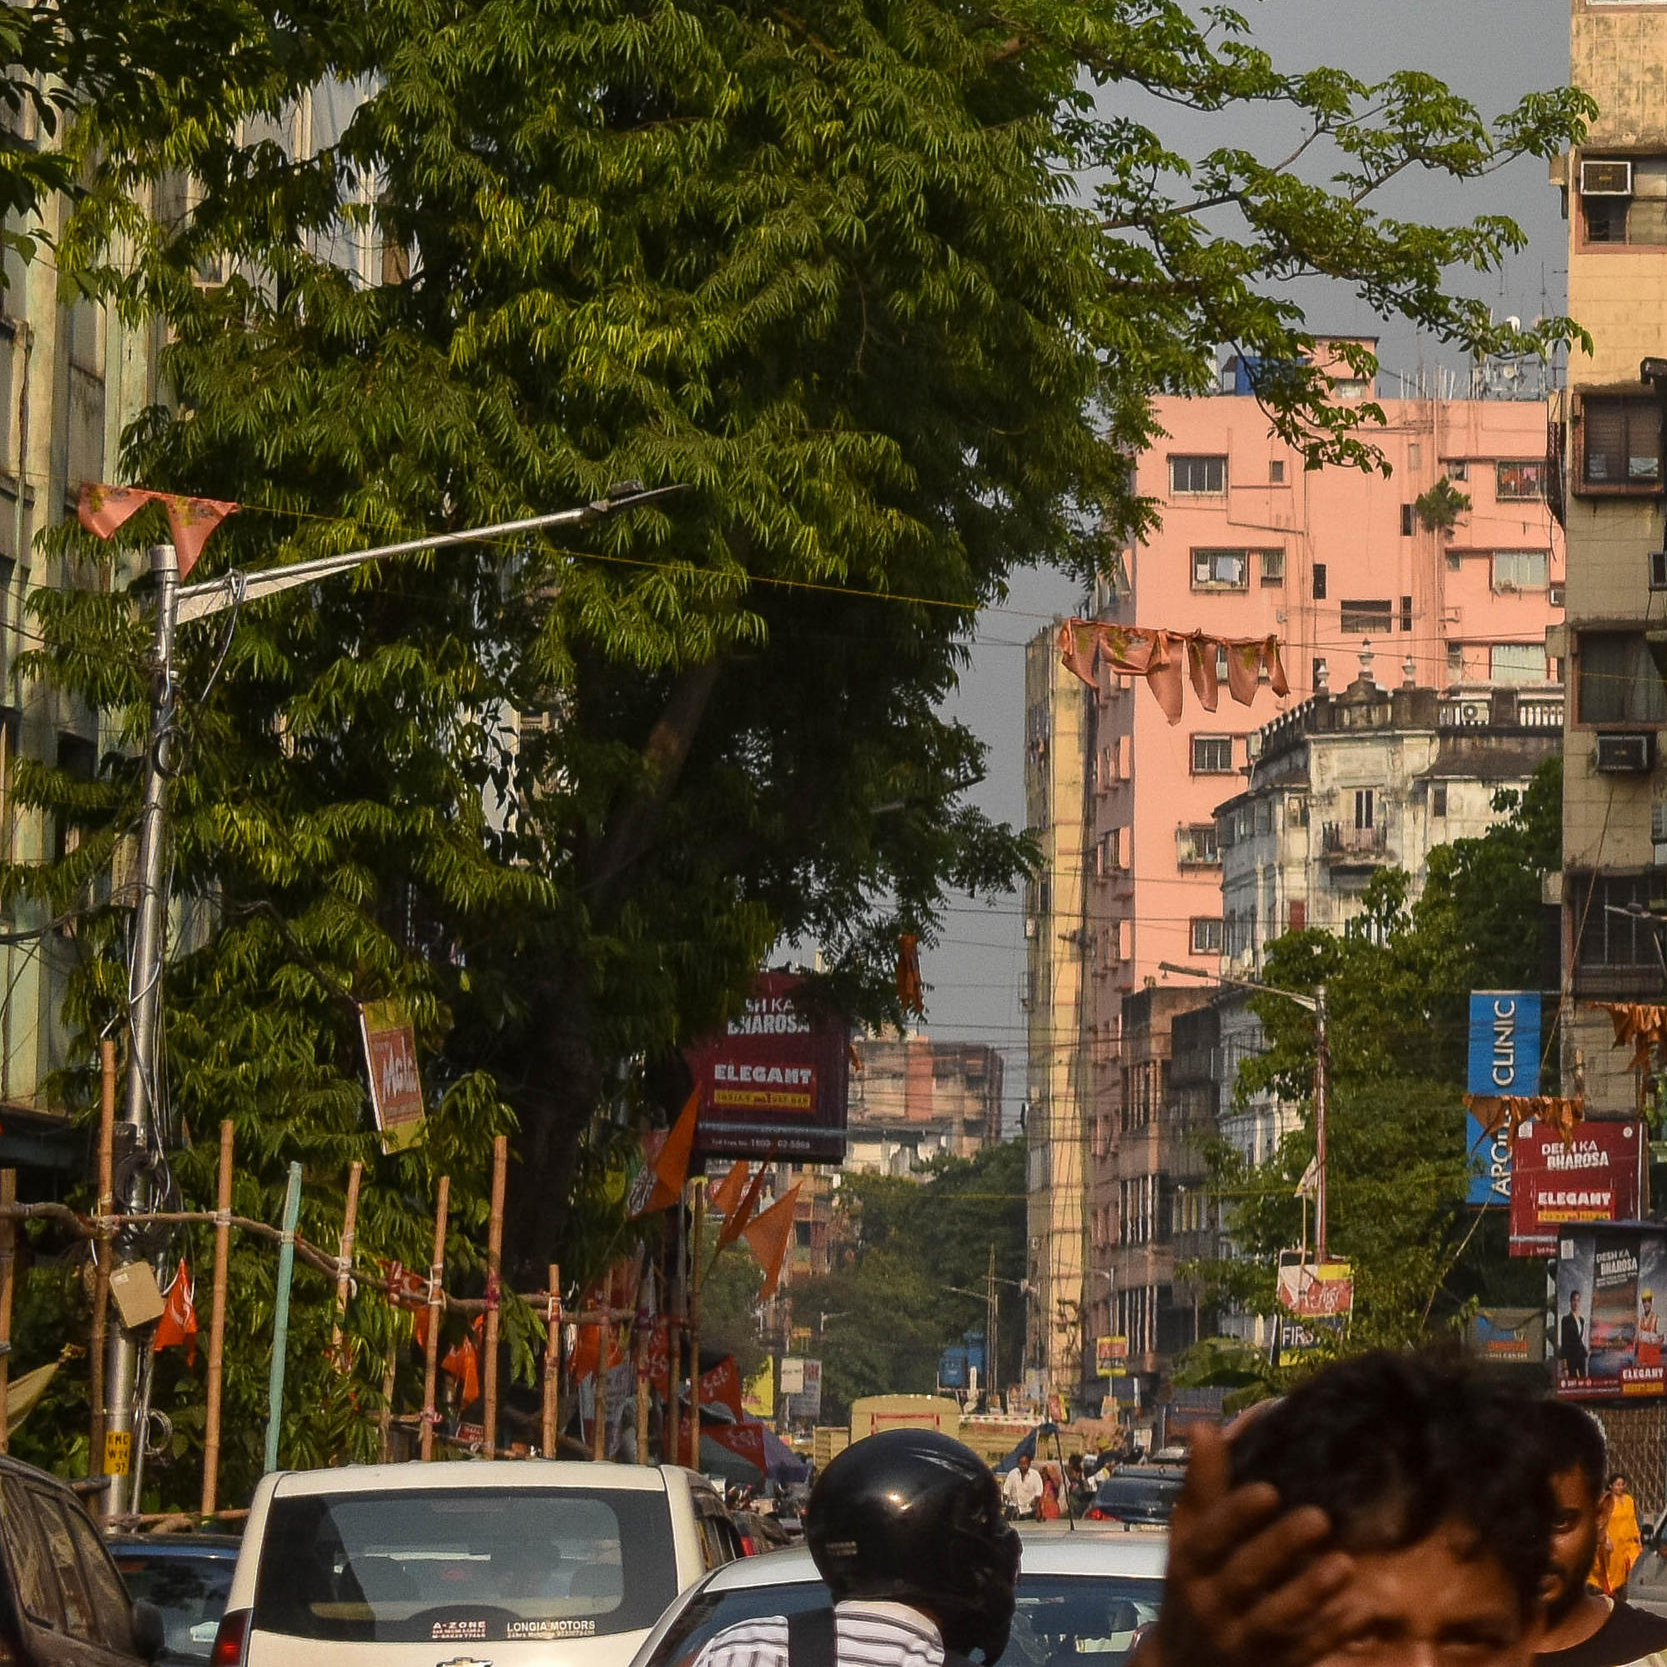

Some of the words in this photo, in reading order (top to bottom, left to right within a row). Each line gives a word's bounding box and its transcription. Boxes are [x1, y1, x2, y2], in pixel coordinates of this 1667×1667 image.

[1492, 1000, 1515, 1087] CLINIC
[714, 1064, 812, 1084] ELEGANT
[1579, 1140, 1598, 1152] KA
[1547, 1150, 1610, 1171] BHAROSA
[1538, 1191, 1611, 1206] ELEGANT
[507, 1621, 547, 1632] LONGIA
[550, 1620, 596, 1631] MOTORS
